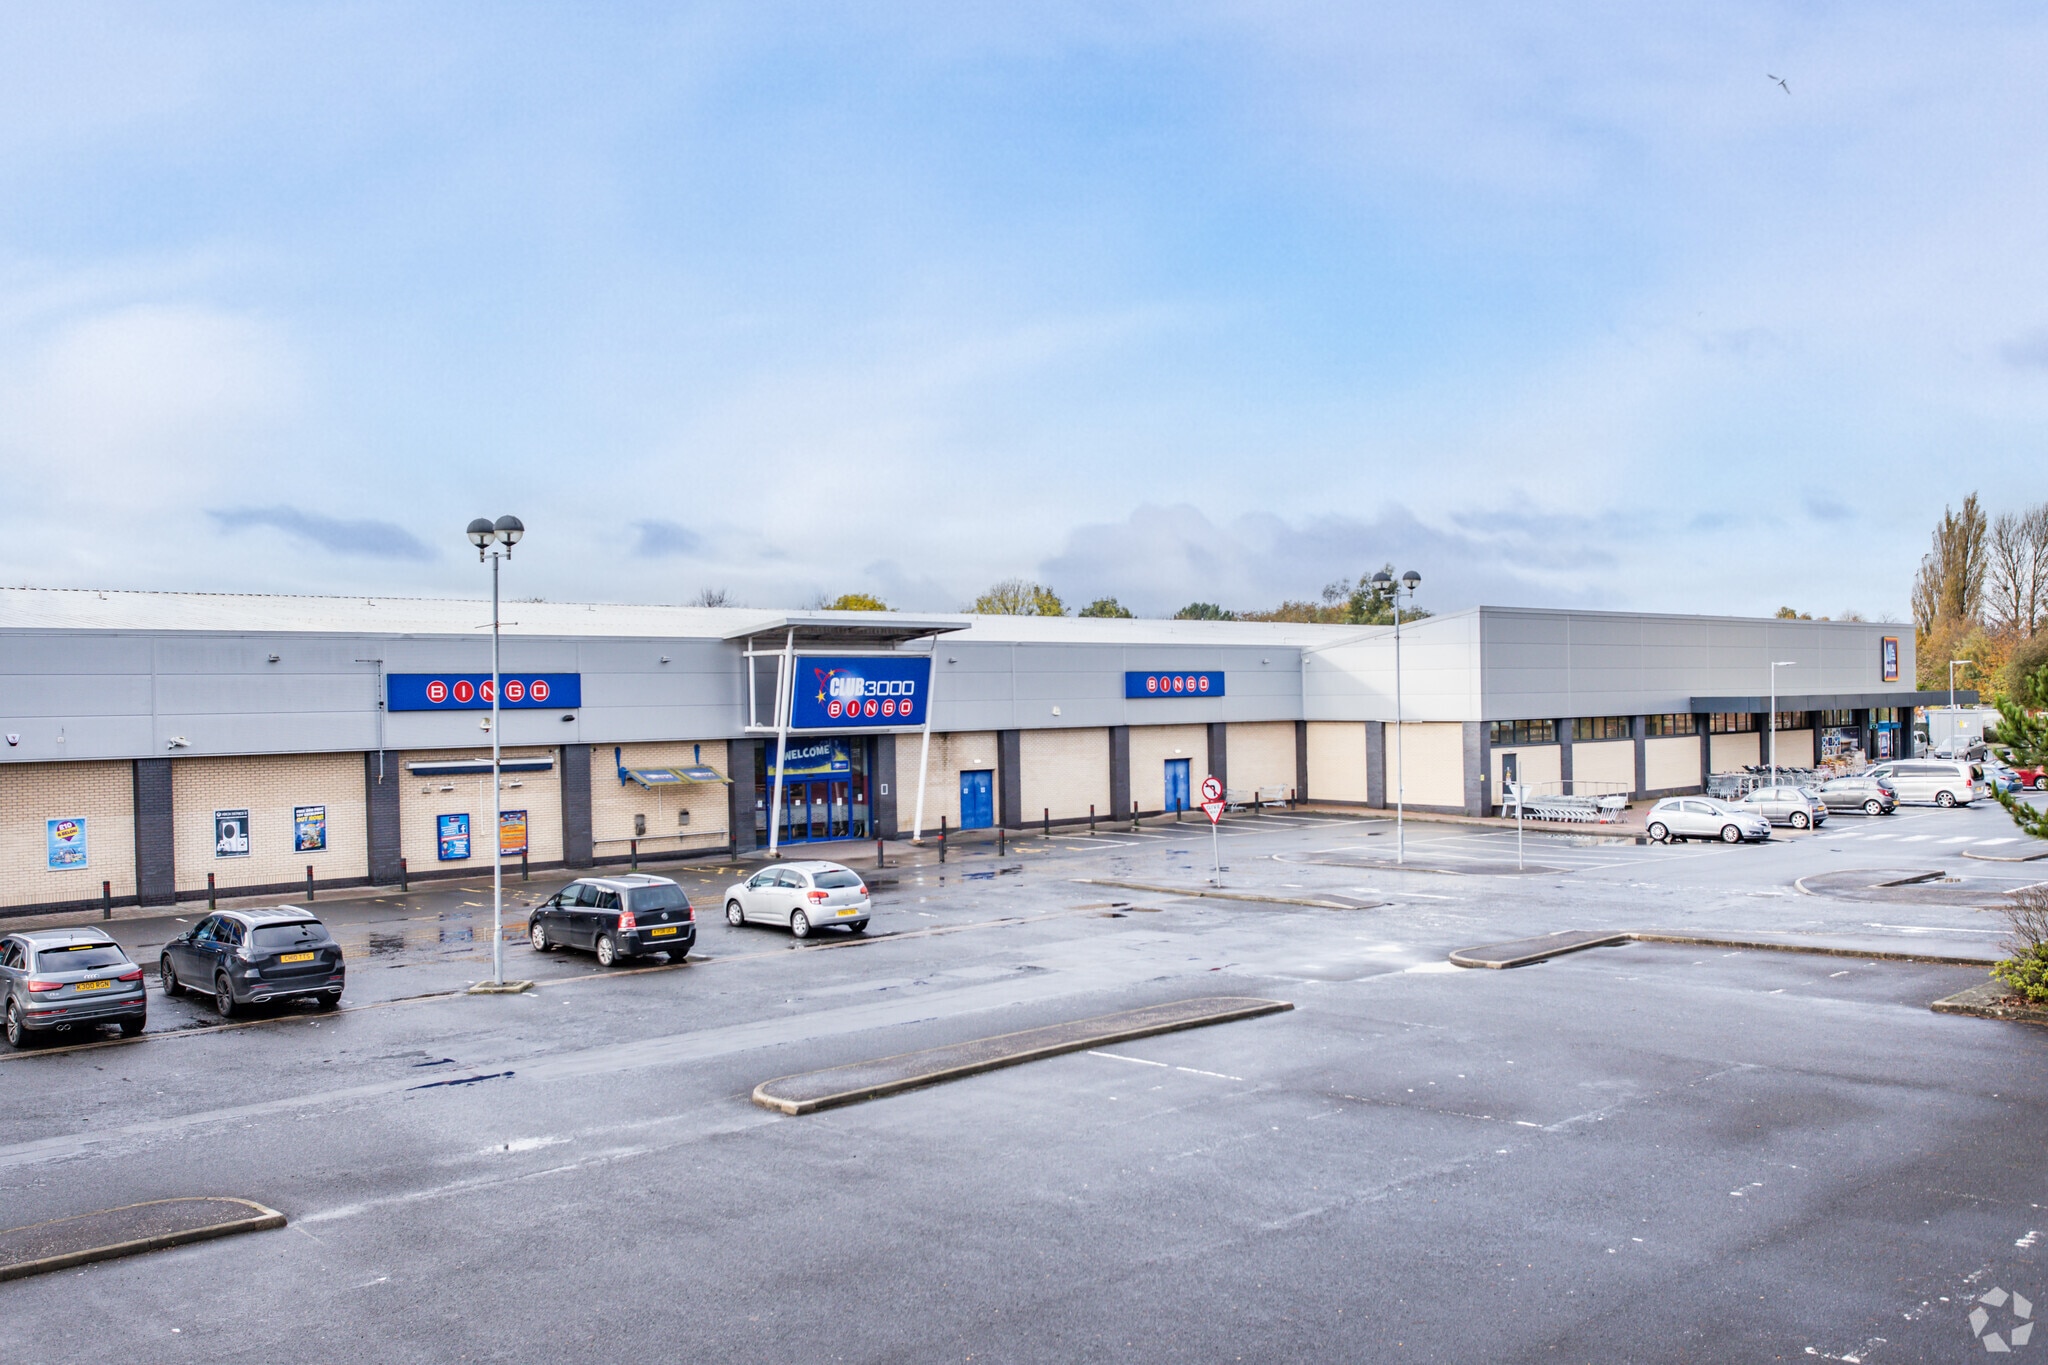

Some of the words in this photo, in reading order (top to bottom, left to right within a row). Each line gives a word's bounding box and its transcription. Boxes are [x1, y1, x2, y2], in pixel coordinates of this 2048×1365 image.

[429, 683, 547, 700] BINGO
[1148, 678, 1208, 691] BINGO
[829, 701, 912, 716] BINGO
[784, 744, 830, 760] WELCOME
[76, 982, 95, 991] K300
[95, 980, 109, 989] RGN
